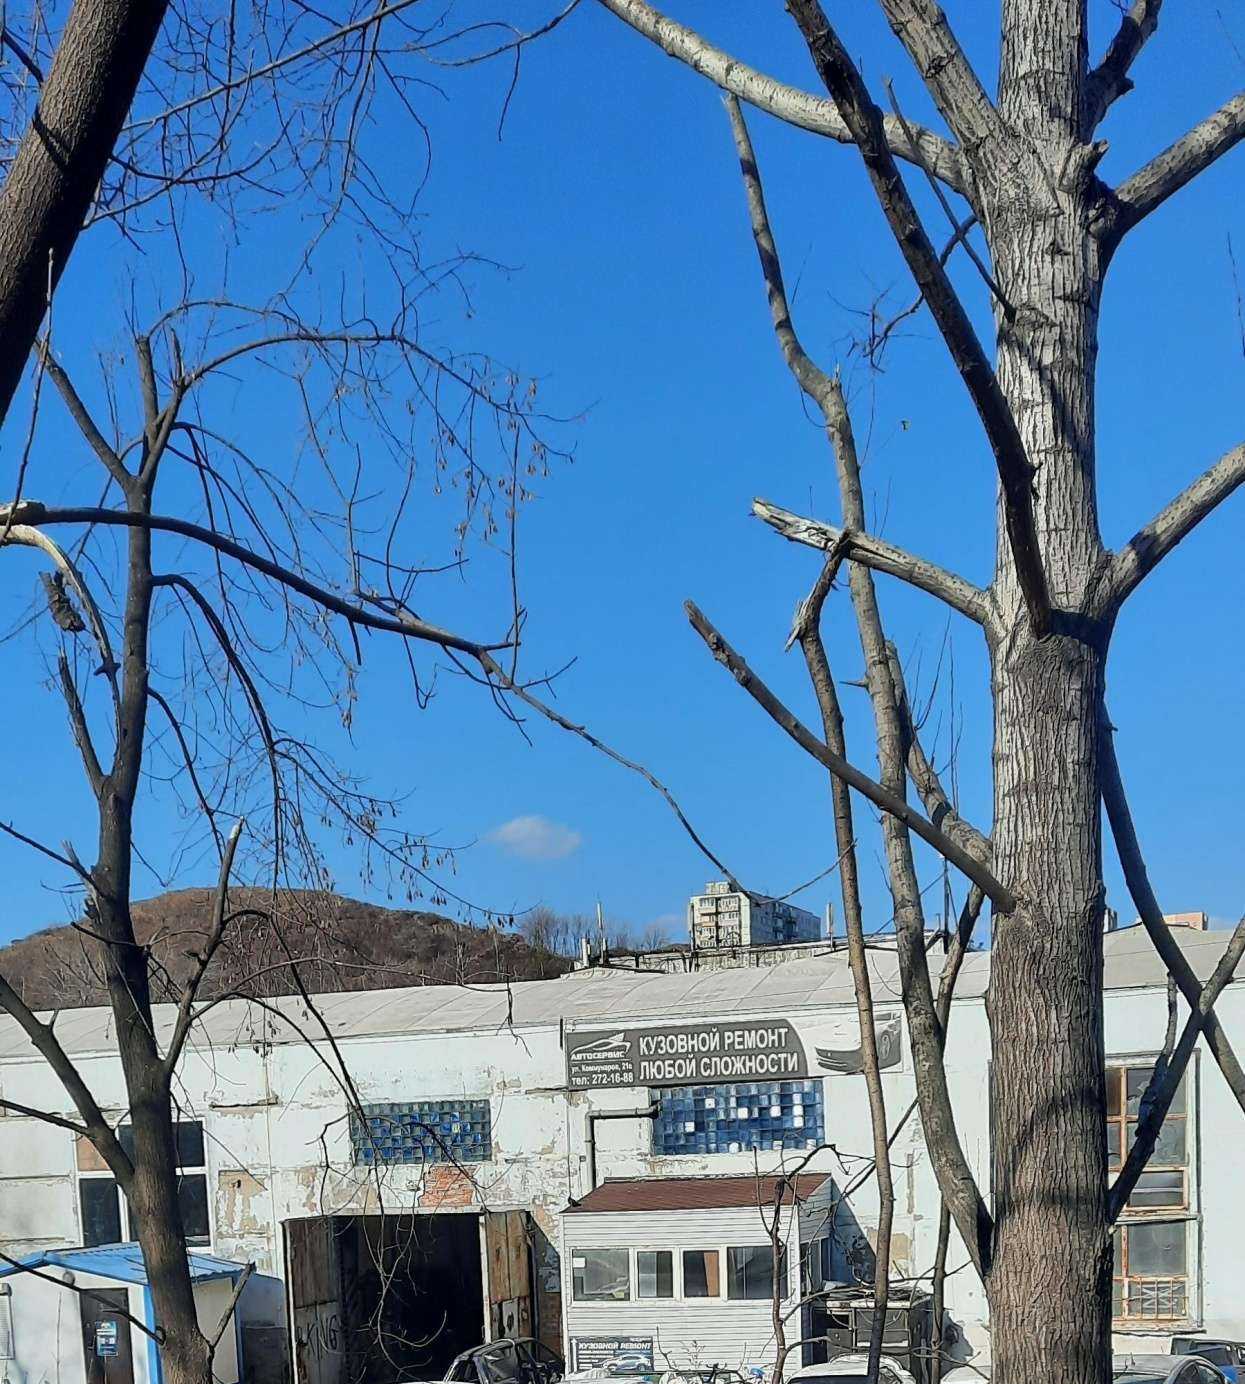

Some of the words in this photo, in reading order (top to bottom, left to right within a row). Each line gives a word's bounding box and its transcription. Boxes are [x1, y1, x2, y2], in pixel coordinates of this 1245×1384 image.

[638, 1027, 720, 1056] КУЗОВНОЙ
[724, 1027, 789, 1051] РЕМОНТ
[570, 1050, 626, 1060] АВТОСЕРВИС
[638, 1054, 697, 1081] ЛЮБОЙ
[700, 1052, 799, 1077] СЛОЖНОСТИ
[571, 1076, 590, 1086] тел:
[591, 1071, 634, 1085] 272-16-88
[578, 1341, 619, 1350] КУЗОВНОЙ
[620, 1342, 652, 1350] РЕМОНТ
